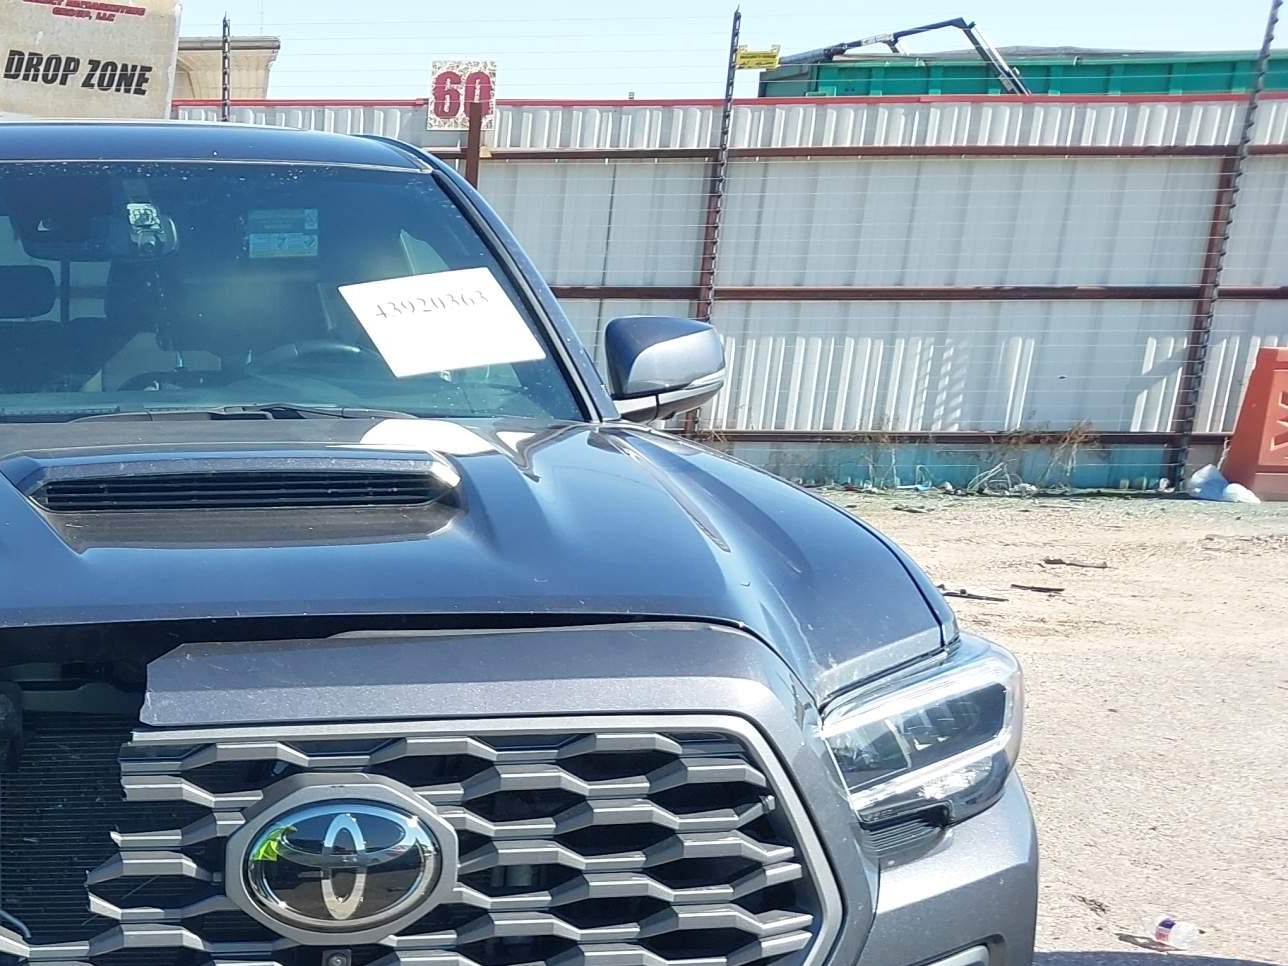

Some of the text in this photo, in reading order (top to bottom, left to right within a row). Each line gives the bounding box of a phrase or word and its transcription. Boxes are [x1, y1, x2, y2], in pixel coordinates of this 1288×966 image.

[96, 11, 116, 22] LLC
[3, 49, 153, 96] DROP ZONE
[433, 70, 492, 119] 60
